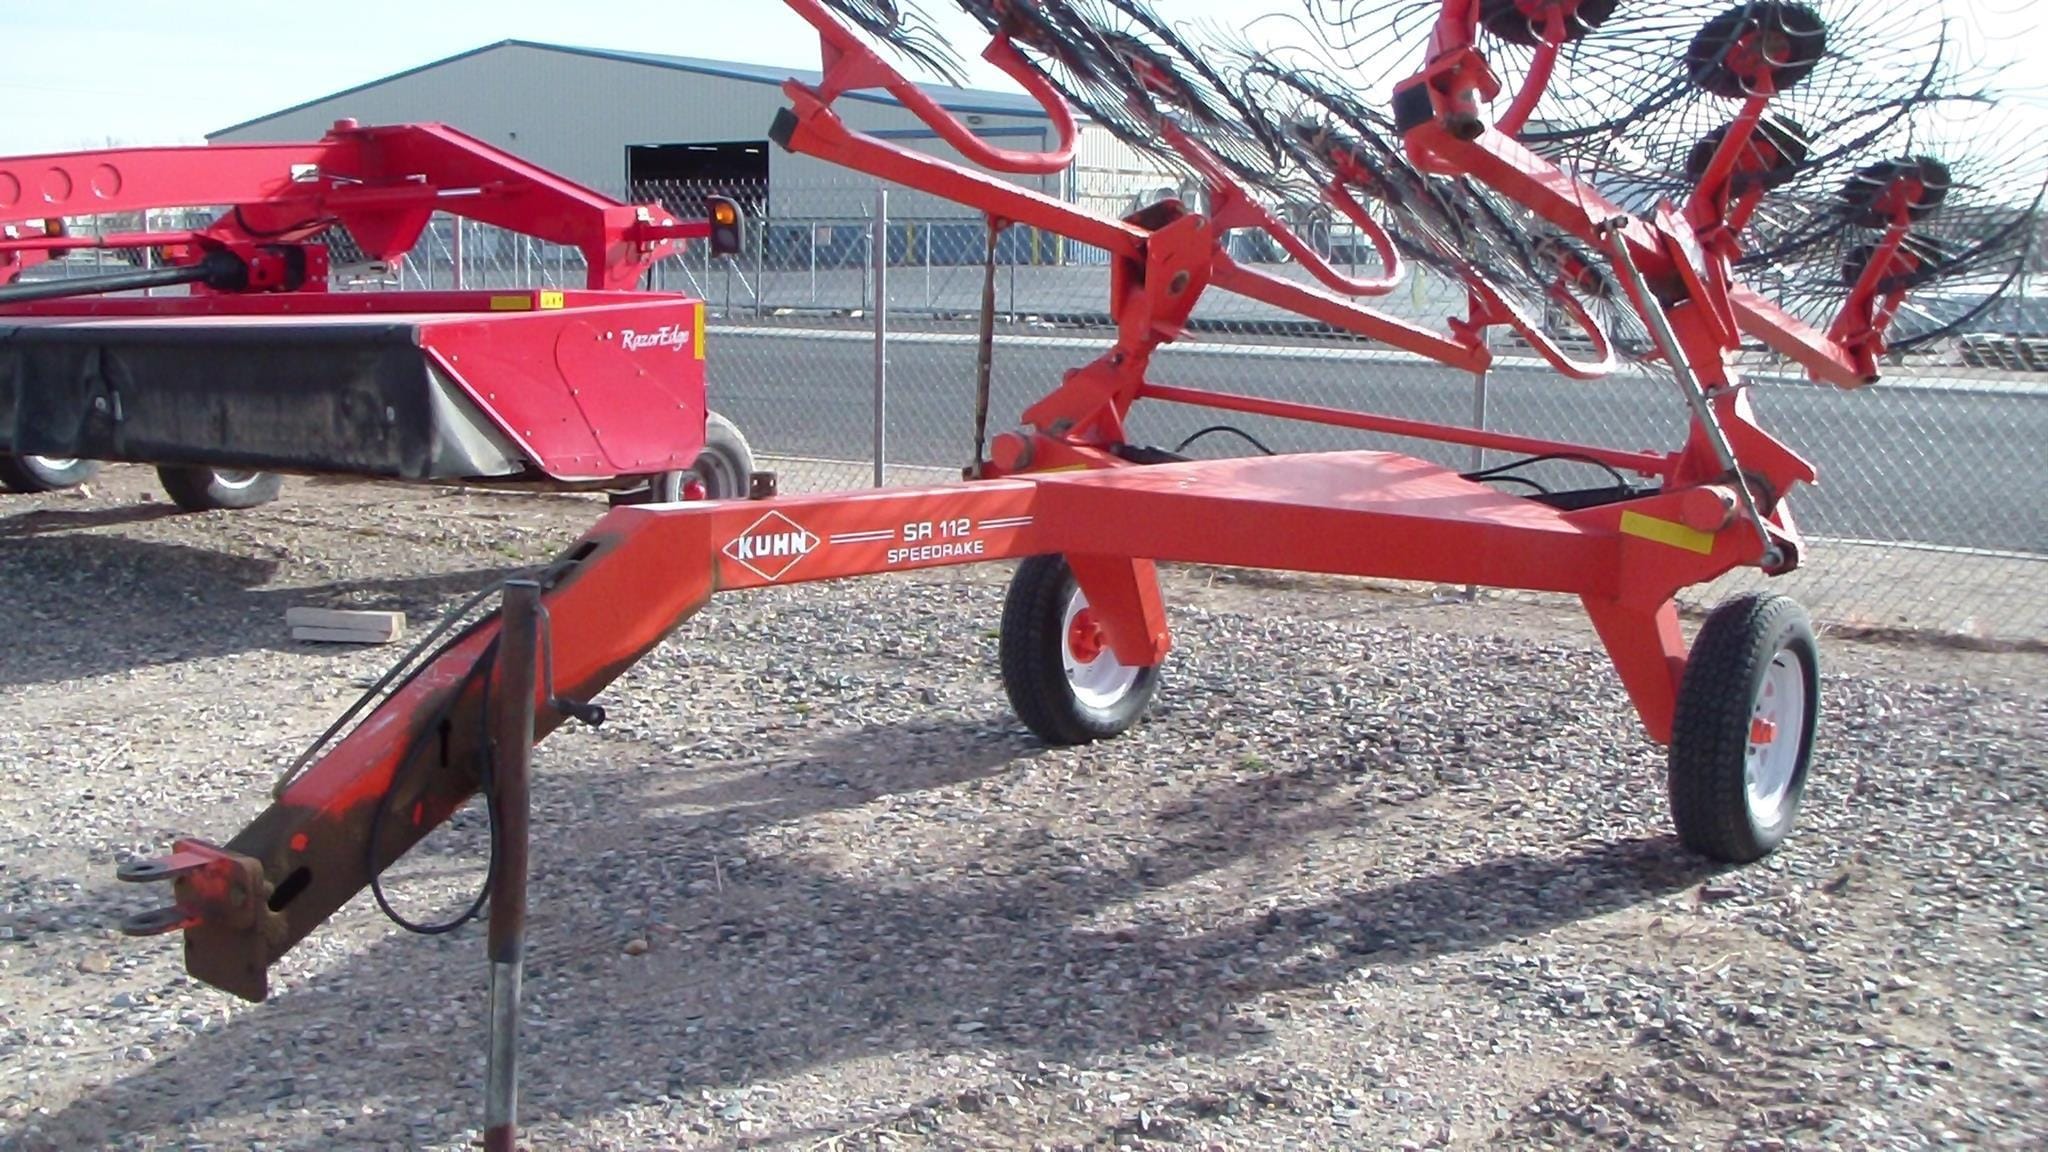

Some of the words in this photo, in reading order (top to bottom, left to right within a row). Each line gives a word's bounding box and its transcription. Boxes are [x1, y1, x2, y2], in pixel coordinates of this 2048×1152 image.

[621, 324, 689, 351] RazorEdge
[903, 521, 932, 542] SR
[939, 518, 971, 538] 112
[738, 531, 807, 560] KUHN
[887, 540, 984, 563] SPEEDRAKE
